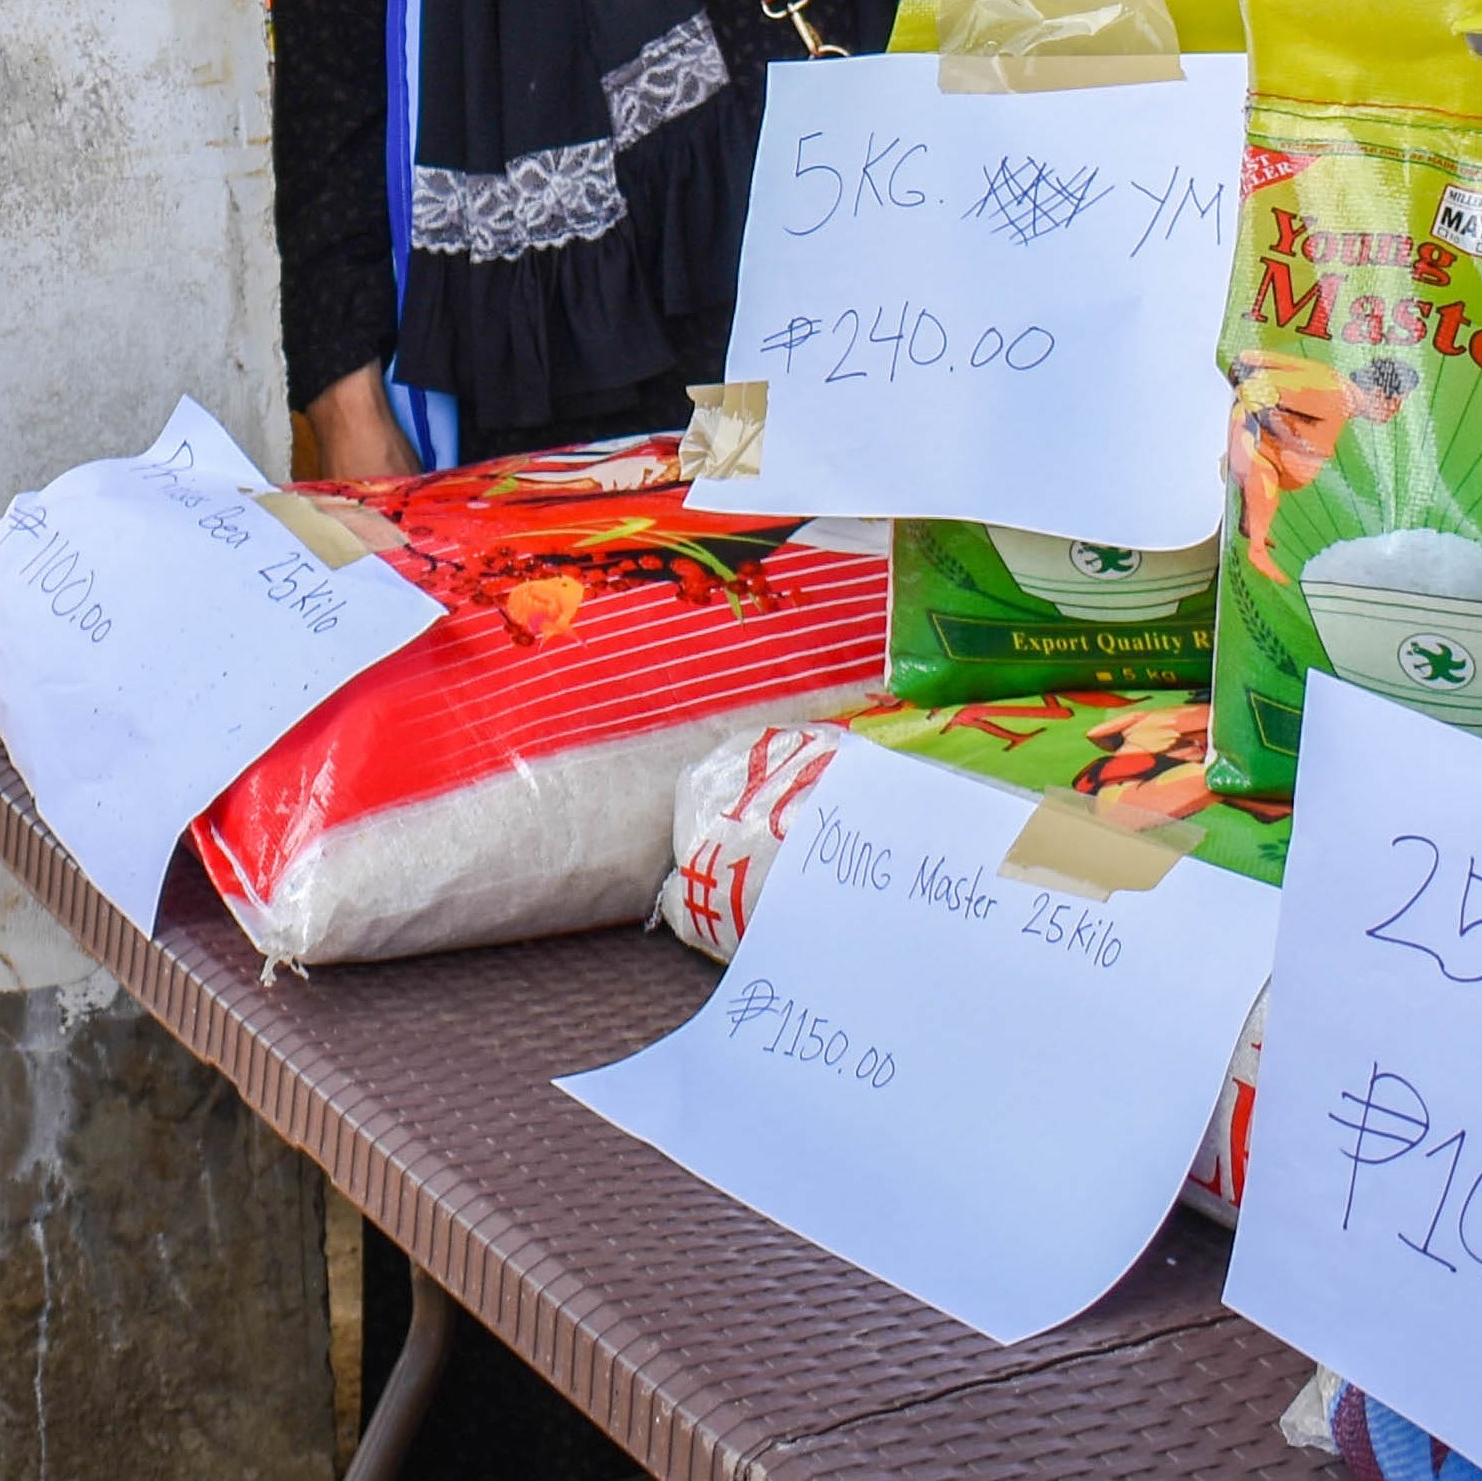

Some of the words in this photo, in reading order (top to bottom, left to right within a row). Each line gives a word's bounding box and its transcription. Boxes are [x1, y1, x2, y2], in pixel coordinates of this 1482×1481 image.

[1130, 165, 1225, 258] YM
[1269, 206, 1458, 287] Young
[1012, 631, 1090, 655] Export
[1096, 631, 1182, 655] Quality
[1122, 667, 1137, 681] 5
[908, 854, 998, 920] Master
